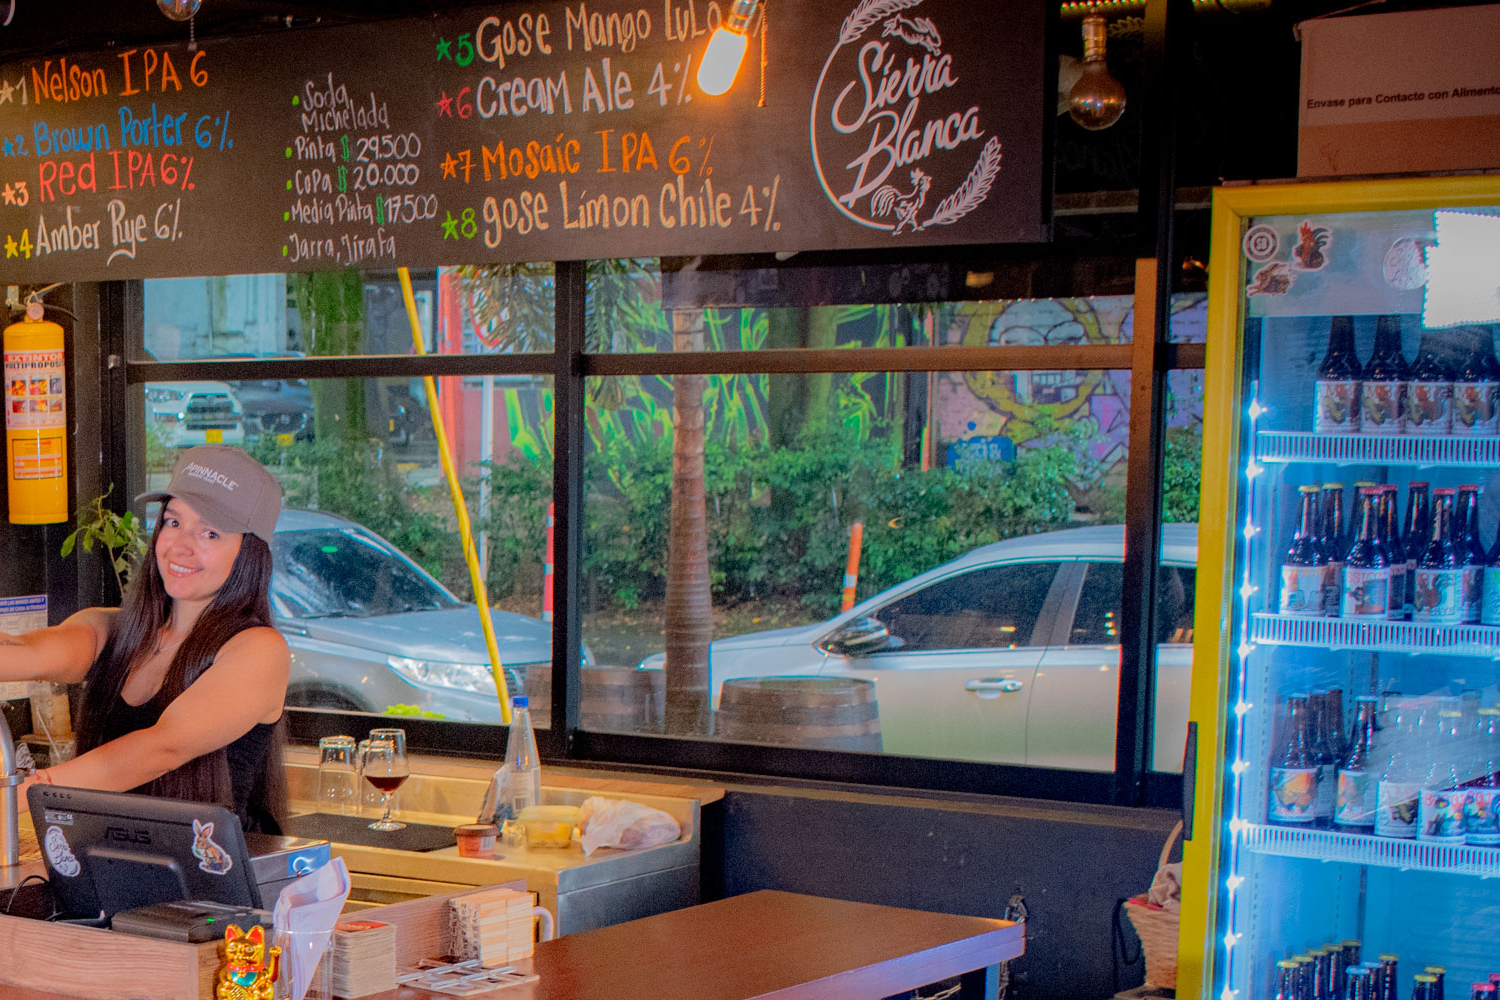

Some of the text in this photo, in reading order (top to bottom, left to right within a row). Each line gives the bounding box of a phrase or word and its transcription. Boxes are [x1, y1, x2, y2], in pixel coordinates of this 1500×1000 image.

[476, 13, 551, 69] Gose
[566, 3, 652, 54] Mango
[32, 58, 108, 103] Nelson
[118, 49, 183, 96] IPA
[190, 51, 208, 87] 6
[303, 72, 349, 111] Soda
[582, 57, 633, 112] Ale
[647, 54, 692, 106] 4%
[832, 40, 959, 133] Sierra
[1307, 98, 1345, 109] Envase
[1348, 97, 1372, 108] para
[1375, 92, 1425, 104] Contacto
[1428, 90, 1448, 100] con
[34, 121, 108, 157] Brown
[118, 104, 184, 149] Porter
[195, 110, 234, 151] 6%
[302, 92, 390, 133] Michelada
[295, 135, 336, 163] Pinta
[356, 132, 422, 162] 29.500
[482, 133, 581, 182] Mosaic
[594, 129, 660, 175] IPA
[668, 134, 714, 178] 6%
[840, 97, 986, 204] Blanca
[38, 154, 97, 202] Red
[353, 163, 420, 190] 20.000
[292, 197, 334, 226] Media
[336, 192, 374, 226] Pinta
[660, 173, 733, 227] Chile
[740, 176, 781, 232] 4%
[36, 206, 100, 257] Amber
[107, 199, 147, 266] Rye
[155, 199, 183, 241] 6%
[187, 462, 237, 491] PINNACLE
[104, 825, 152, 845] ASUS
